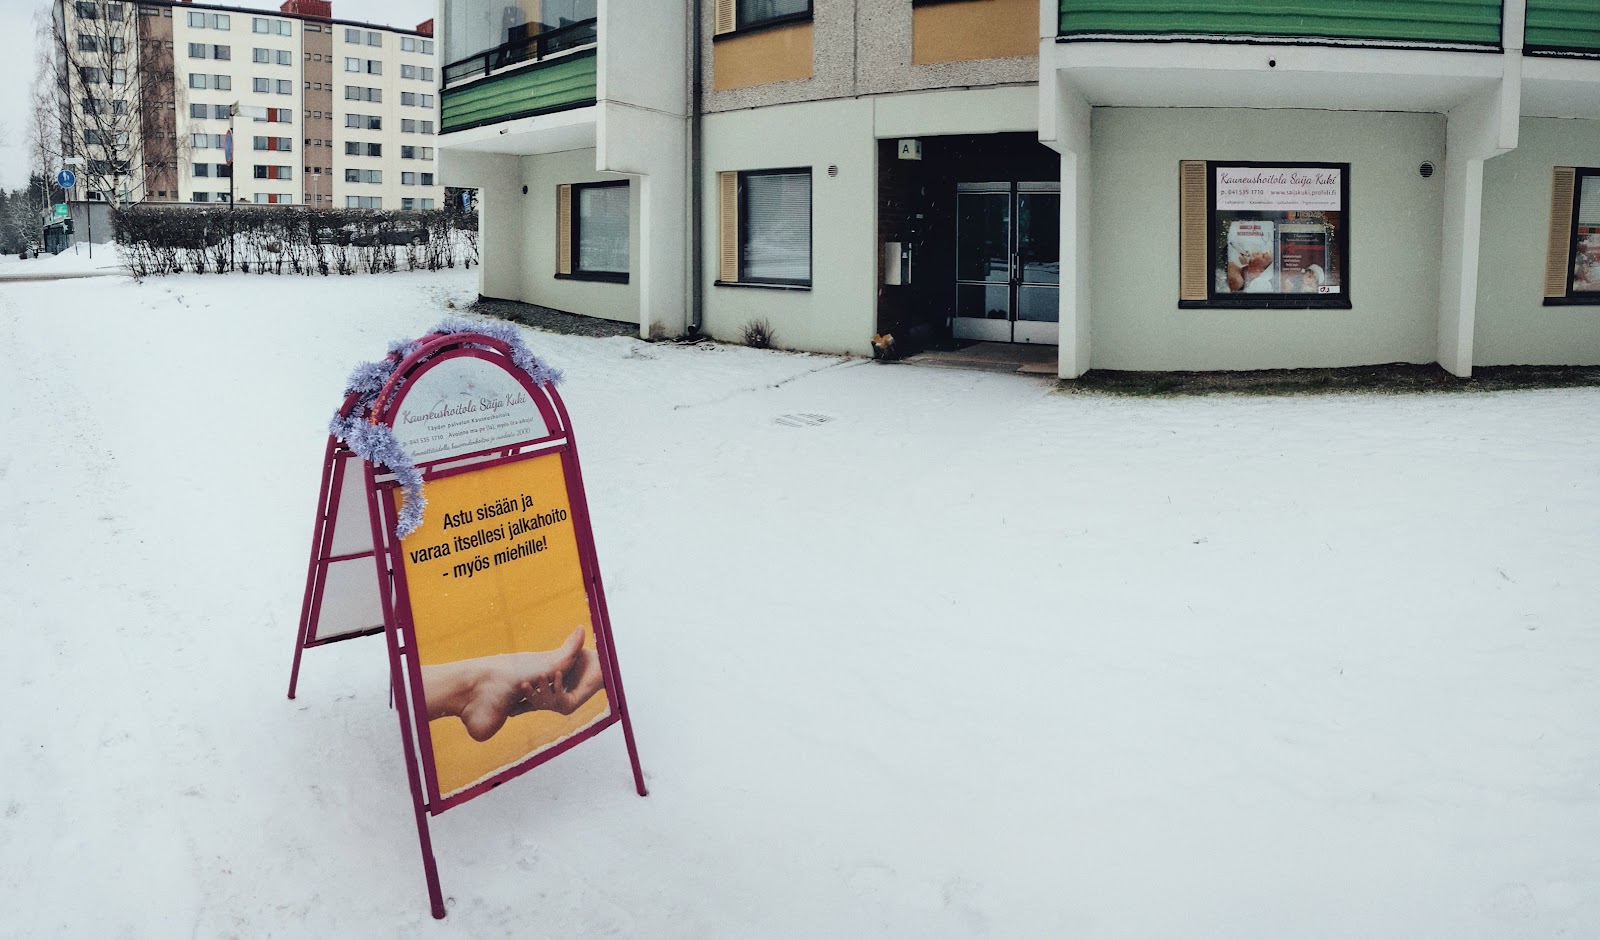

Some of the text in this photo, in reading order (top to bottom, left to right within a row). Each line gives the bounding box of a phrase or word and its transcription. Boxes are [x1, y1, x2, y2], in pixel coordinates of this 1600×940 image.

[902, 144, 910, 154] A
[1220, 172, 1337, 187] Kauneushoitola Saija Kuki
[402, 392, 527, 425] Kauneushoitola Saija Kuki
[420, 436, 430, 444] 535
[448, 429, 469, 438] Avoinna
[516, 426, 531, 437] 2000
[443, 493, 534, 530] Astu sisään ja
[410, 508, 567, 564] varaa itsellesi jalkahoito
[453, 555, 490, 578] myös
[493, 535, 548, 566] miehille!
